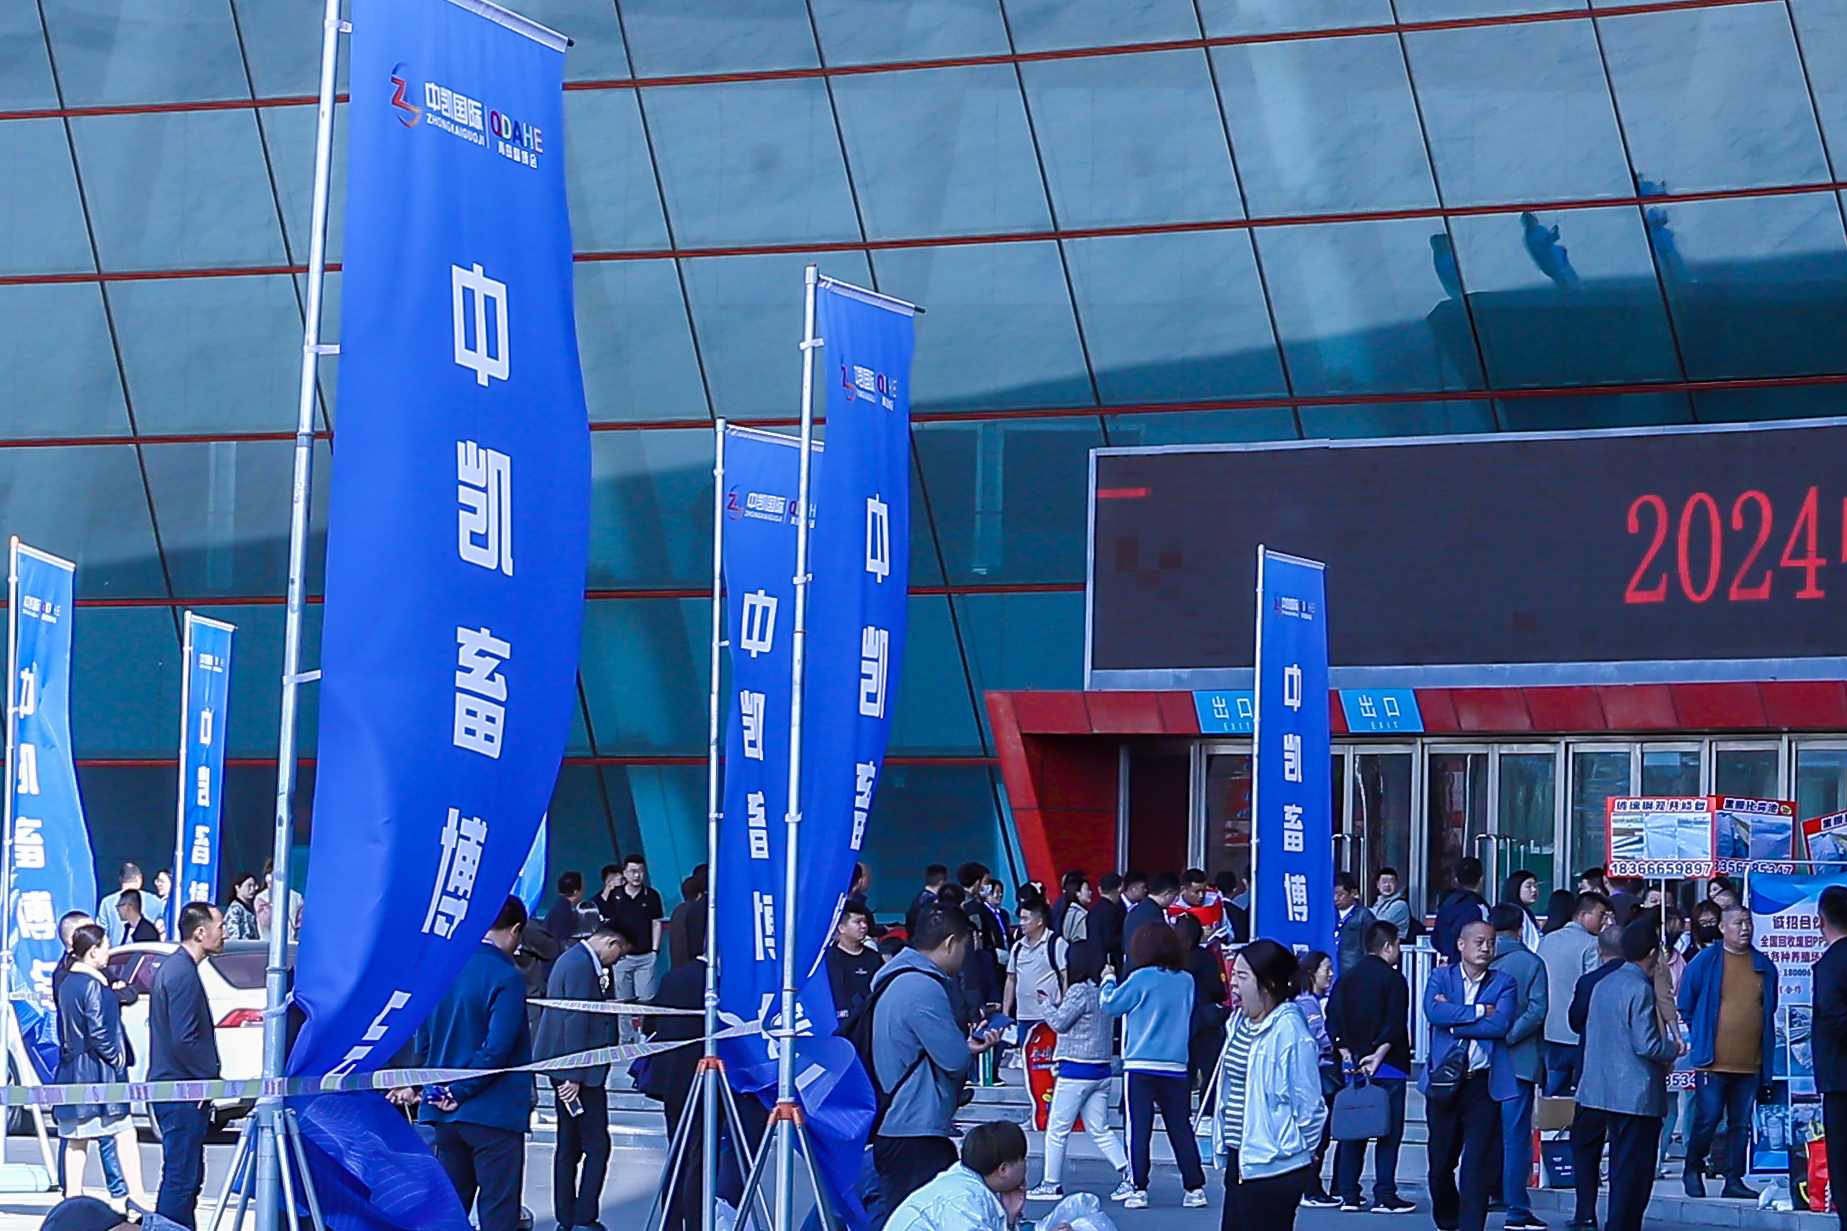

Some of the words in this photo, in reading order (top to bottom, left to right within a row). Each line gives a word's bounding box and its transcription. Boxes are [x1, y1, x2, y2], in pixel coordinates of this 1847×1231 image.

[424, 81, 484, 131] 中凯国际
[1211, 695, 1253, 719] 出口
[1358, 694, 1401, 718] 出口
[1611, 862, 1713, 876] 18366659897
